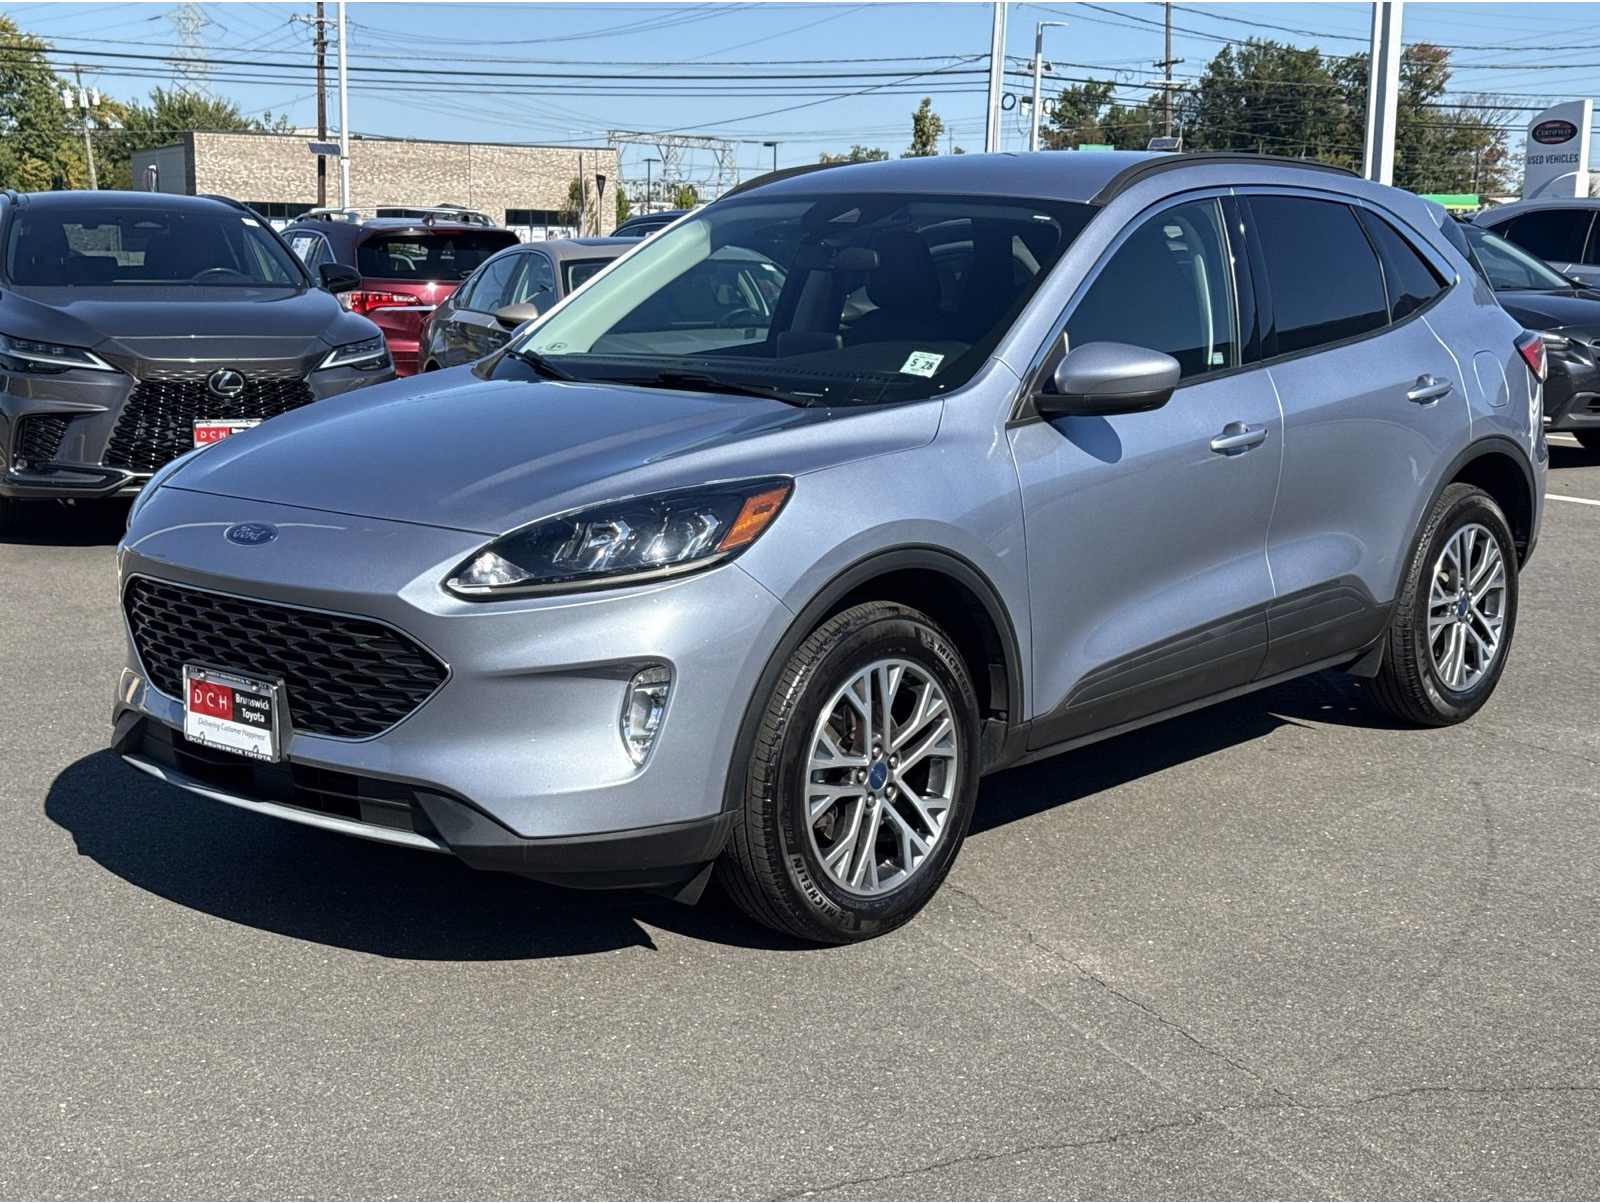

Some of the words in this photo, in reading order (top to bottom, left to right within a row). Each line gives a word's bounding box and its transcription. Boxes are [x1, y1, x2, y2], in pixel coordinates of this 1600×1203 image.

[1527, 155, 1544, 165] USED
[1546, 153, 1579, 164] VEHICLES
[194, 688, 228, 711] DCH
[235, 692, 269, 710] Brunswick
[241, 708, 265, 723] Toyota
[244, 751, 272, 762] TOYOTA
[793, 857, 837, 917] MICHELIN
